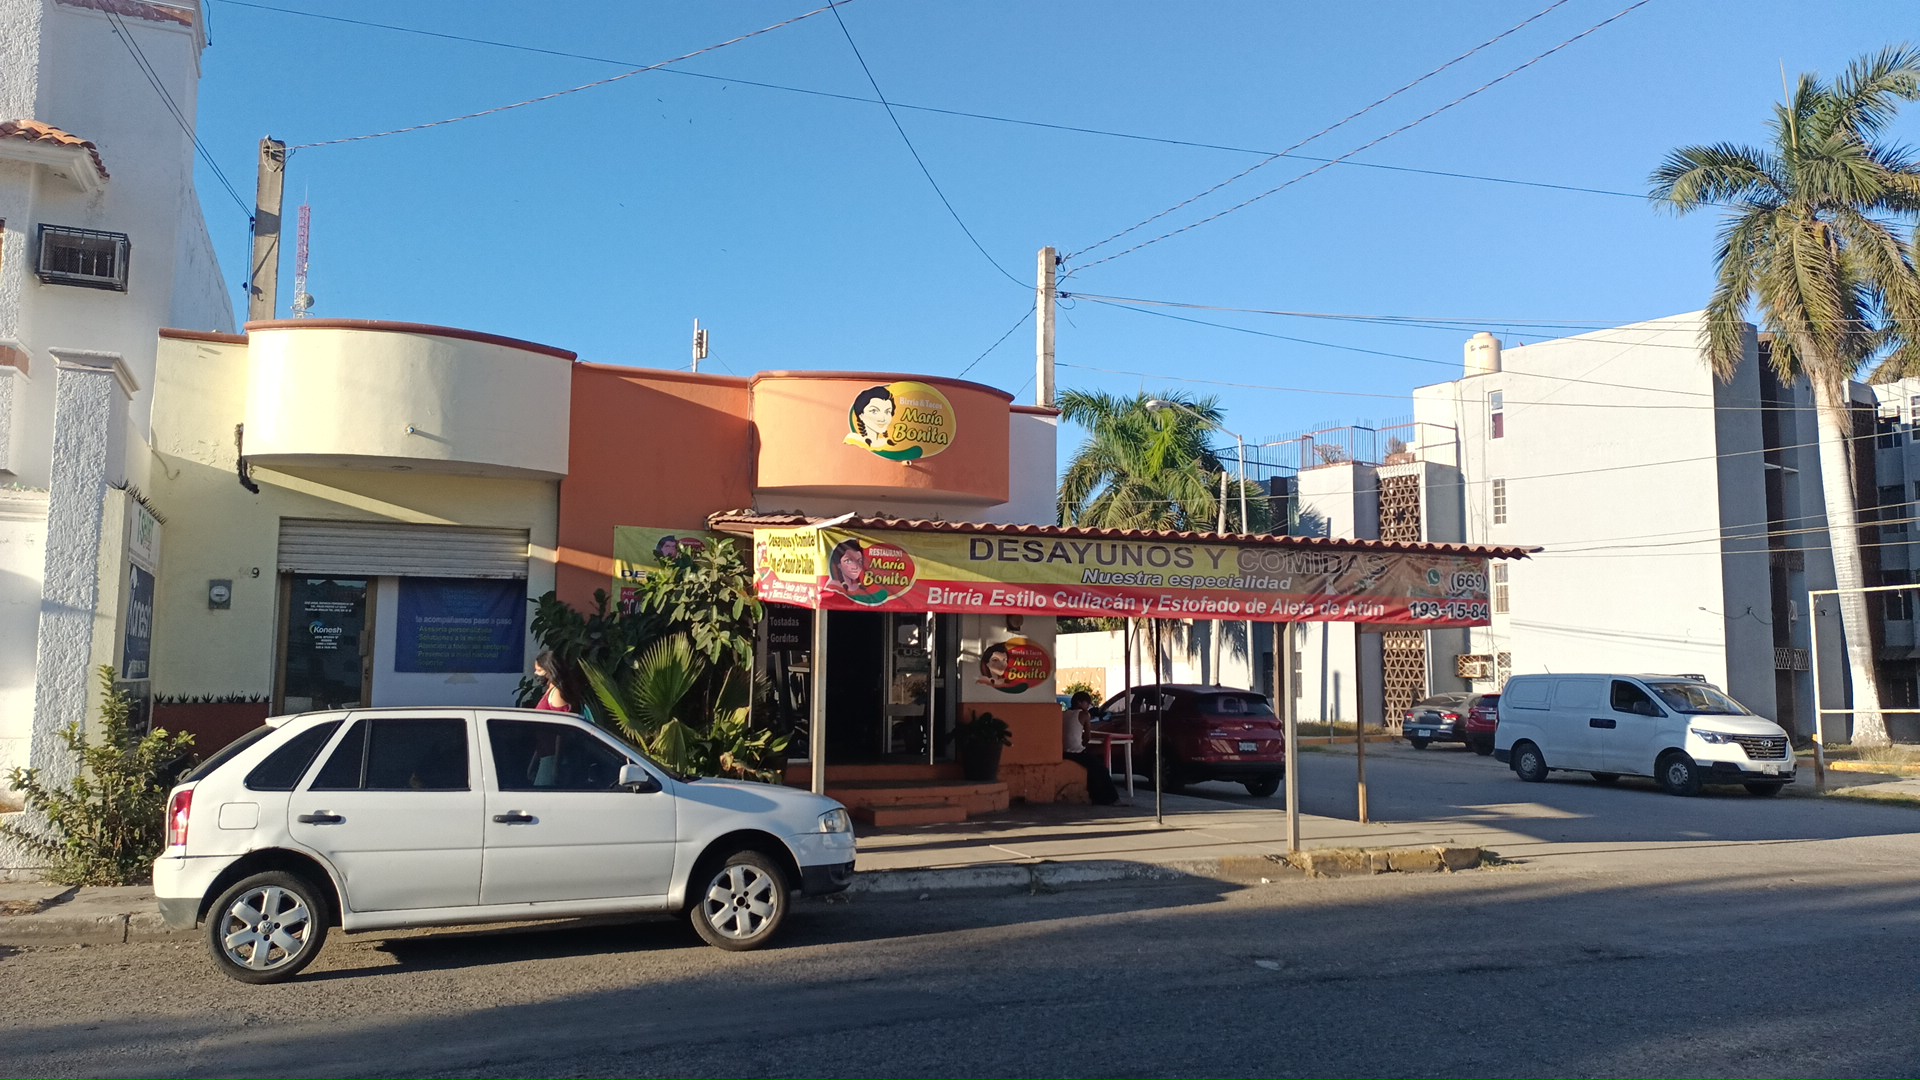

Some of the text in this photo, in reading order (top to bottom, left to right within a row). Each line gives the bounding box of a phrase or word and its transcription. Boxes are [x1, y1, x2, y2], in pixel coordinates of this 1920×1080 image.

[899, 397, 919, 407] Birria
[925, 400, 943, 410] Tacos
[901, 408, 943, 426] María
[892, 423, 948, 445] Bonita
[869, 557, 905, 570] María
[969, 537, 1388, 576] DESAYUNOS Y COMIDAS
[863, 570, 909, 586] Bonita
[1081, 568, 1293, 590] Nuestra especialidad
[1450, 573, 1488, 593] (669)
[927, 587, 1385, 617] Birria Estilo Culiacán y Estofado de Aleta de Atún
[1408, 601, 1489, 620] 193-15-84
[770, 616, 800, 627] Tostadas
[770, 633, 799, 643] Gorditas
[1013, 657, 1042, 667] María
[1008, 668, 1046, 680] Bonita
